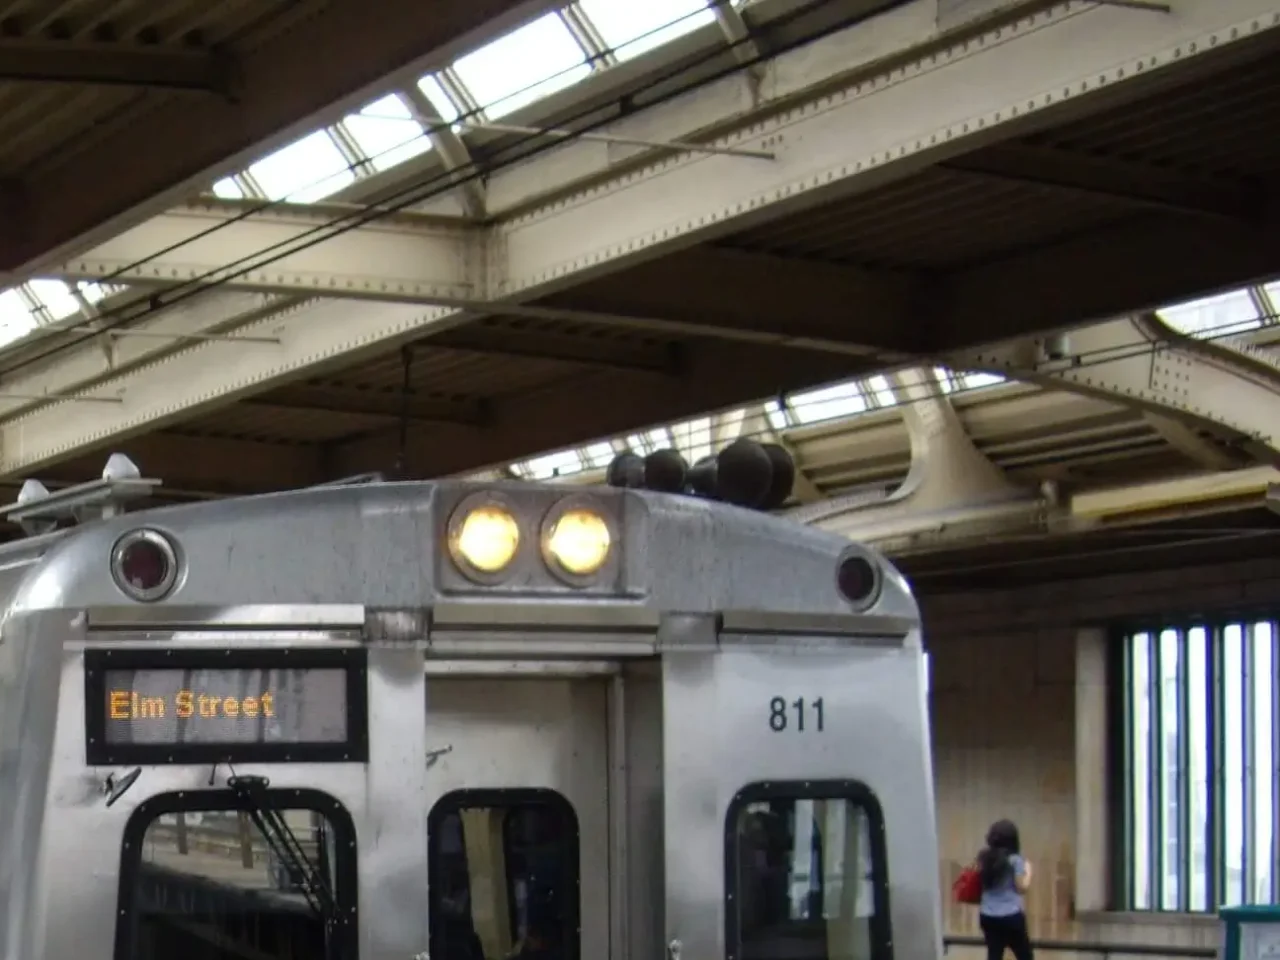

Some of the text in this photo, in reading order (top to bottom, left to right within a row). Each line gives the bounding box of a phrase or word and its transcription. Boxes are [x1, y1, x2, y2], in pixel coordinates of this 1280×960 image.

[109, 689, 276, 719] Elm Street
[769, 695, 824, 733] 811
